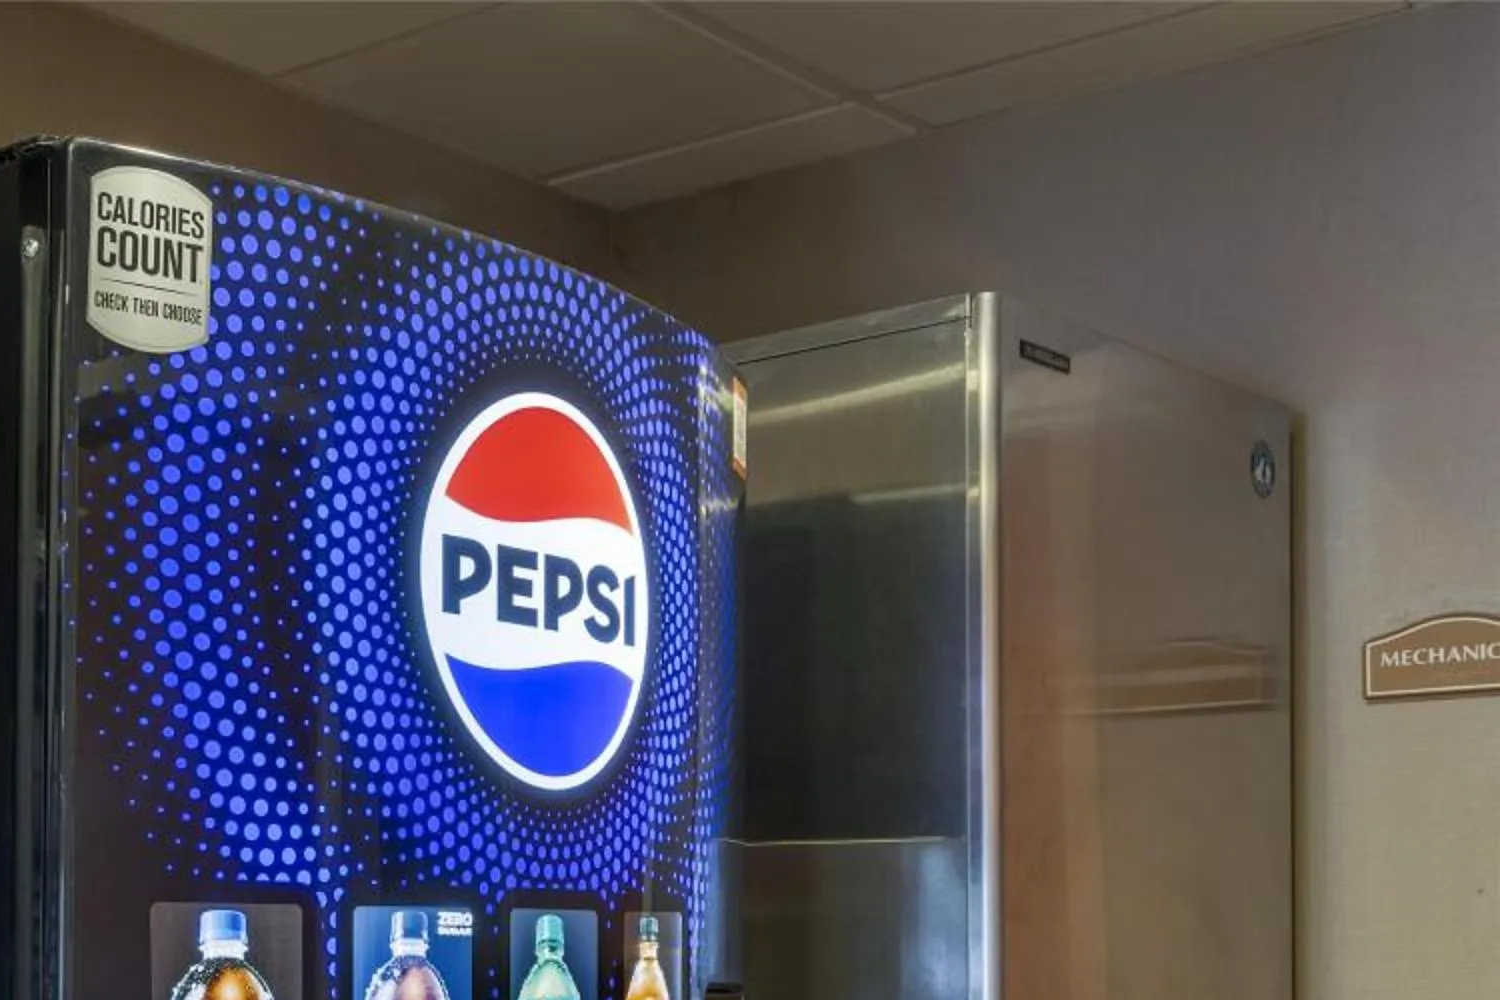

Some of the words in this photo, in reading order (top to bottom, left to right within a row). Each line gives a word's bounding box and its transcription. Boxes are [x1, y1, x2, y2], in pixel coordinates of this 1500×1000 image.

[97, 191, 205, 239] CALORIES
[97, 226, 204, 283] COUNT
[94, 290, 129, 314] CHECK
[133, 297, 160, 318] THEN
[163, 303, 203, 326] CHOOSE
[441, 533, 637, 647] PEPSI
[1381, 641, 1500, 667] MECHANIC
[437, 911, 474, 926] ZERO
